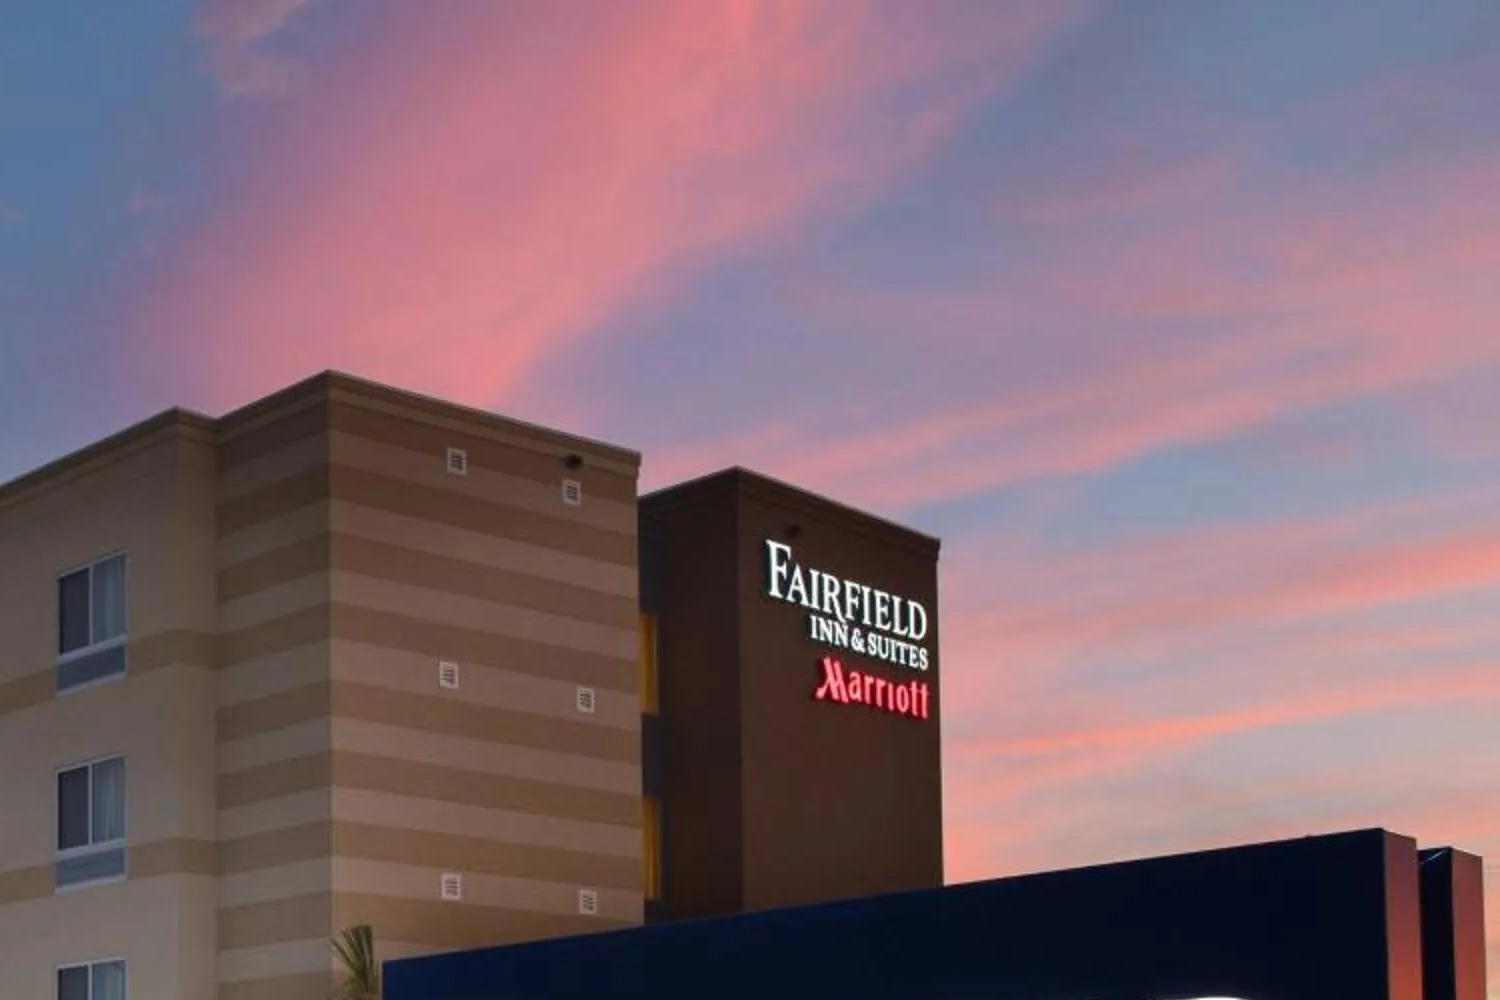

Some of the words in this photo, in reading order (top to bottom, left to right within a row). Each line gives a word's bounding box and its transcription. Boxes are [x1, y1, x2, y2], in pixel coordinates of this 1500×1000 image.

[765, 539, 928, 641] FAIRFIELD
[810, 615, 849, 648] INN
[851, 628, 866, 653] &
[867, 632, 929, 671] SUITES
[815, 656, 930, 719] Marriott
